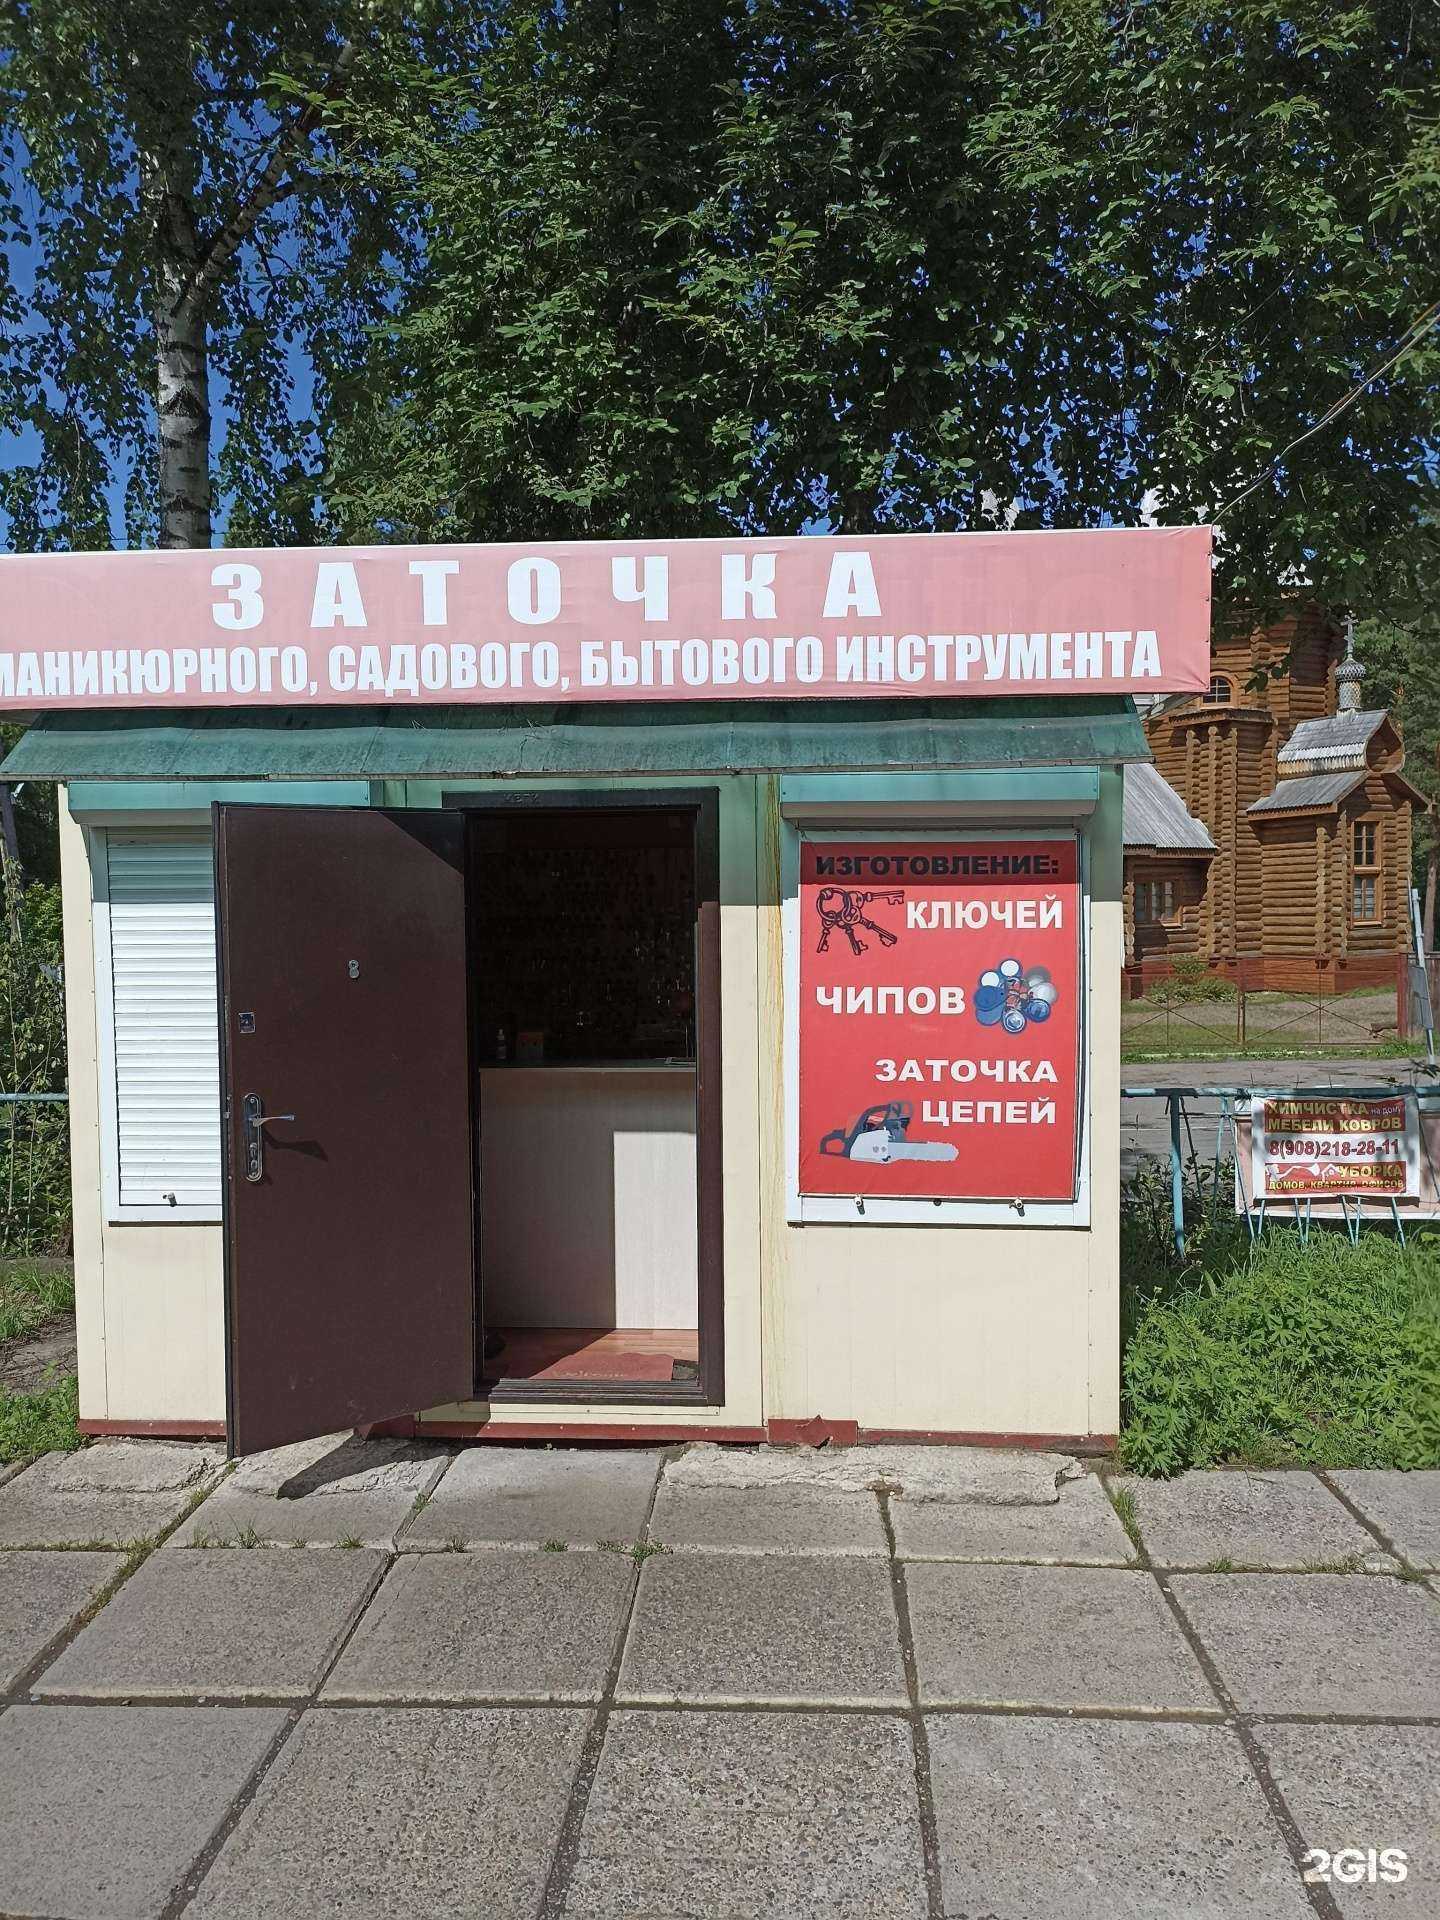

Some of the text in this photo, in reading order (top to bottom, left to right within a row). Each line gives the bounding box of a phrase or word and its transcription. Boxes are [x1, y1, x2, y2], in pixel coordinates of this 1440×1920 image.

[211, 549, 881, 632] ЗАТОЧКА
[328, 641, 570, 697] САДОВОГО,
[580, 635, 826, 688] БЫТОВОГО
[836, 630, 1162, 684] ИНСТРУМЕНТА
[816, 855, 1059, 877] ИЗГОТОВЛЕНИЕ:
[906, 894, 1063, 930] КЛЮЧЕЙ
[815, 986, 966, 1015] ЧИПОВ
[875, 1059, 1058, 1084] ЗАТОЧКА
[922, 1097, 1056, 1127] ЦЕПЕЙ
[1267, 1101, 1369, 1115] ХИМЧИСТКА
[1268, 1117, 1401, 1132] МЕБЕЛИ КОВРОВ
[1269, 1139, 1400, 1159] 8(908)218-28-11
[1340, 1164, 1403, 1178] УБОРКА
